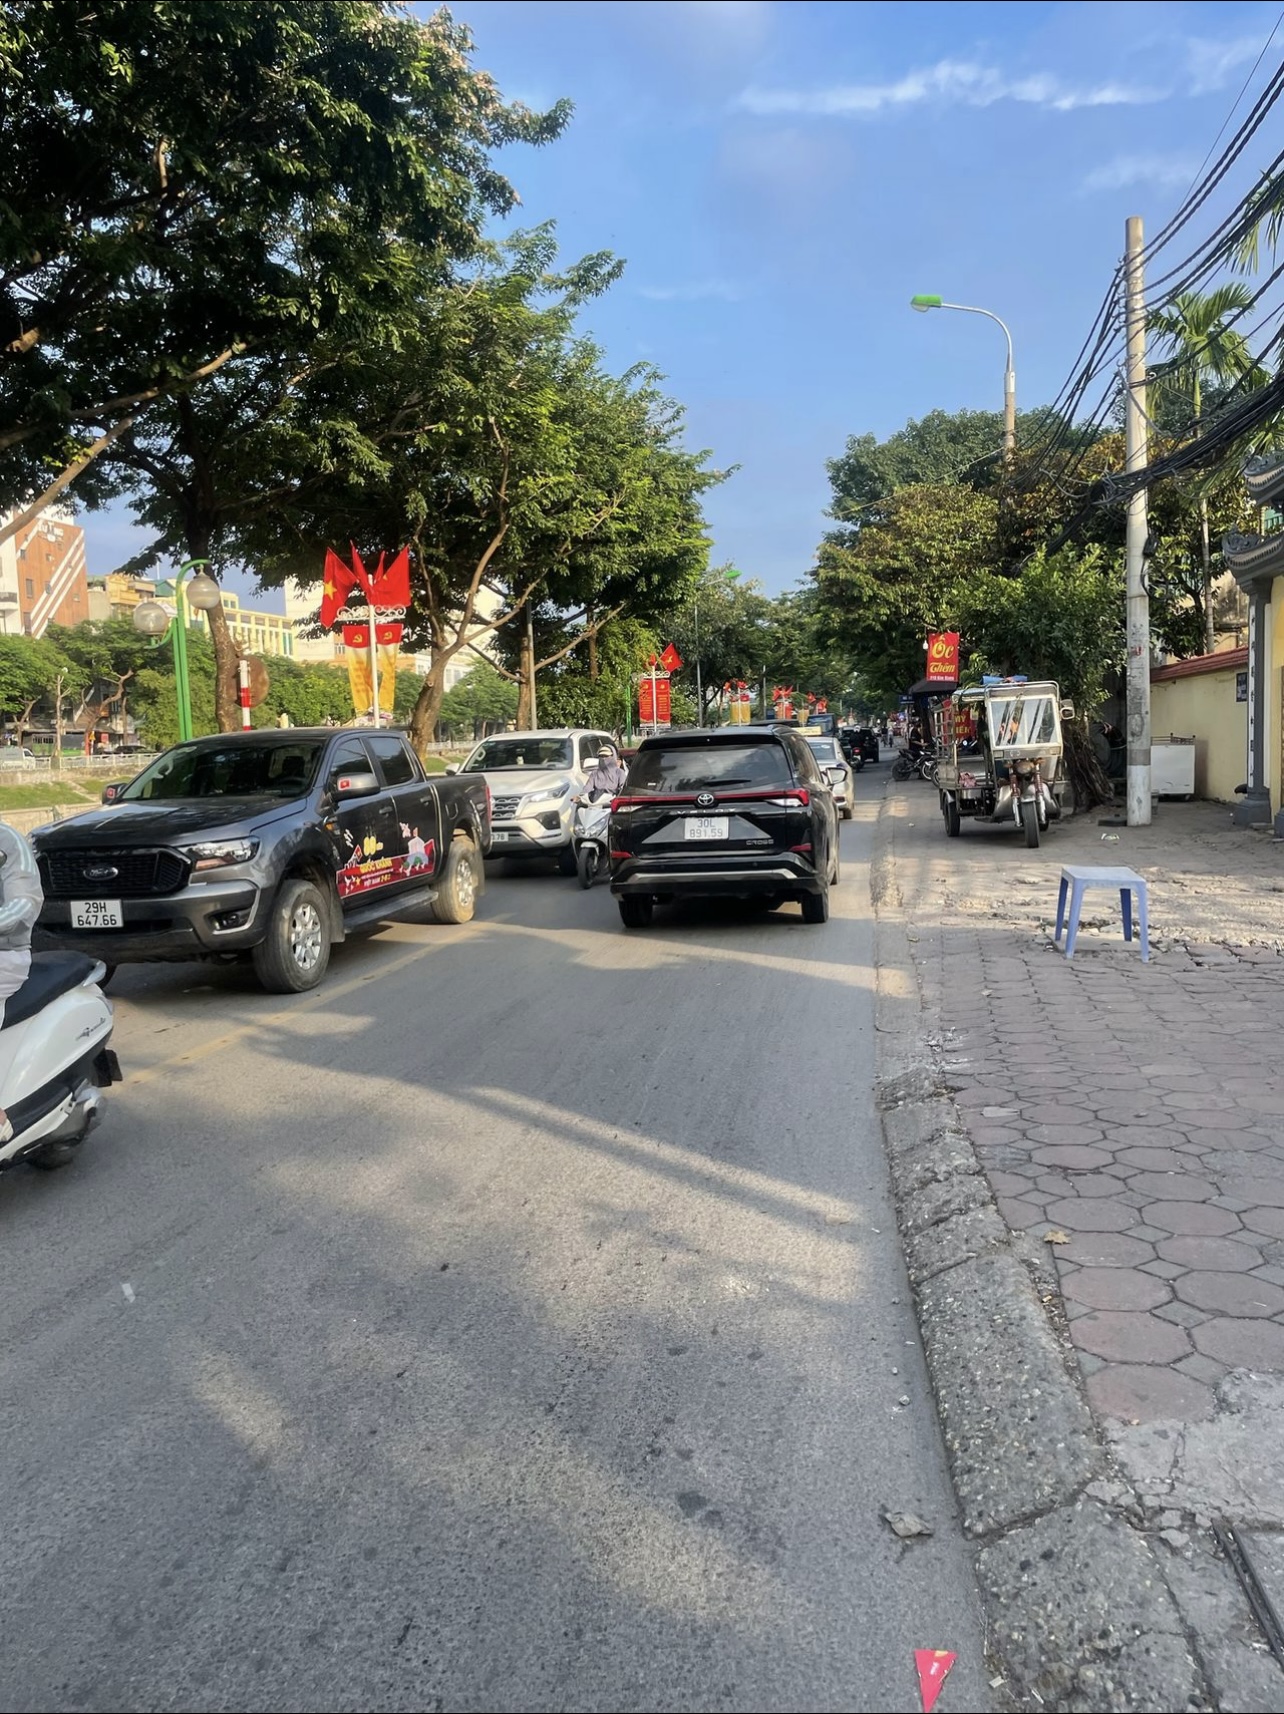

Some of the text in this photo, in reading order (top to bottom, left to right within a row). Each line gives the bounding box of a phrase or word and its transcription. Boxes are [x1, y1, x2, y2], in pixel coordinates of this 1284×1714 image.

[696, 818, 716, 828] 30L
[689, 828, 724, 838] 891.59
[84, 901, 107, 914] 29H
[77, 914, 117, 926] 647.66
